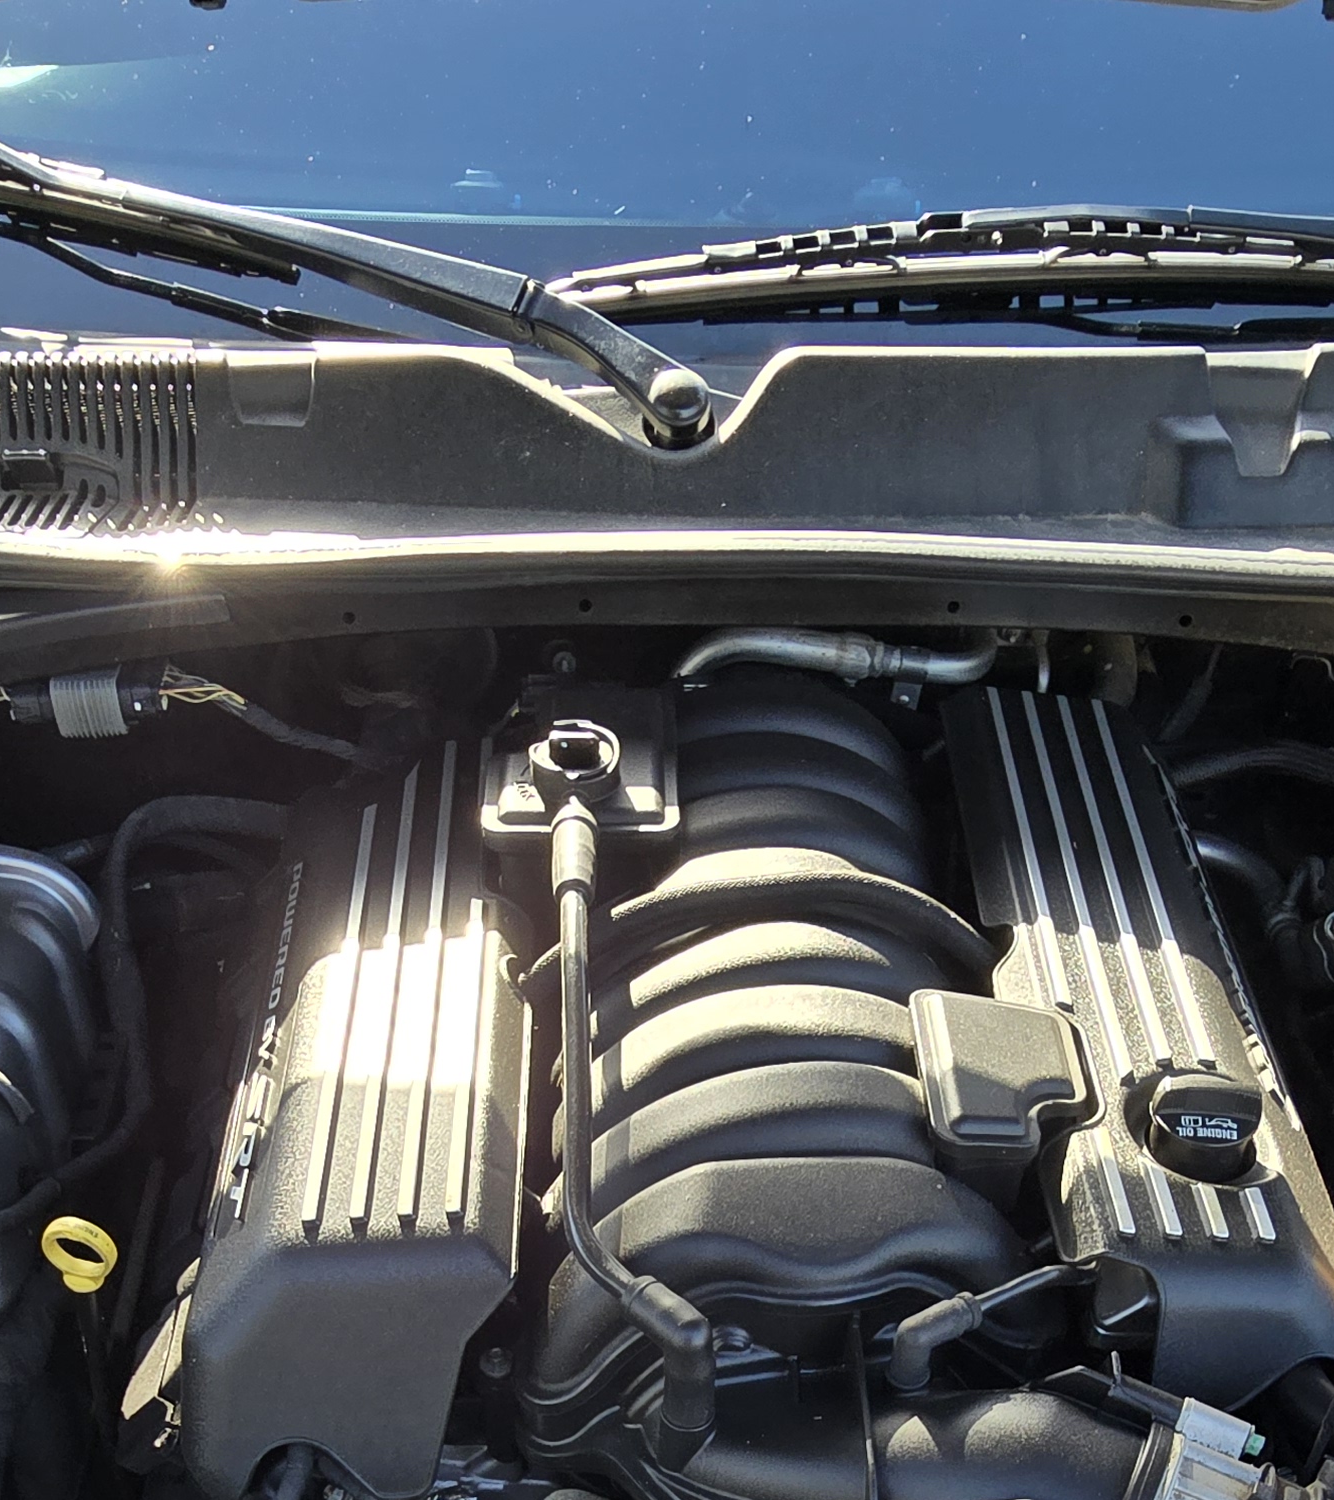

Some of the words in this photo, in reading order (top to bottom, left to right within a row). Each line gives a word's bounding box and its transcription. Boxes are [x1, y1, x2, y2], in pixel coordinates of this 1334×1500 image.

[268, 861, 304, 1010] POWERED
[1176, 1127, 1194, 1137] OIL
[1197, 1128, 1237, 1140] ENGINE
